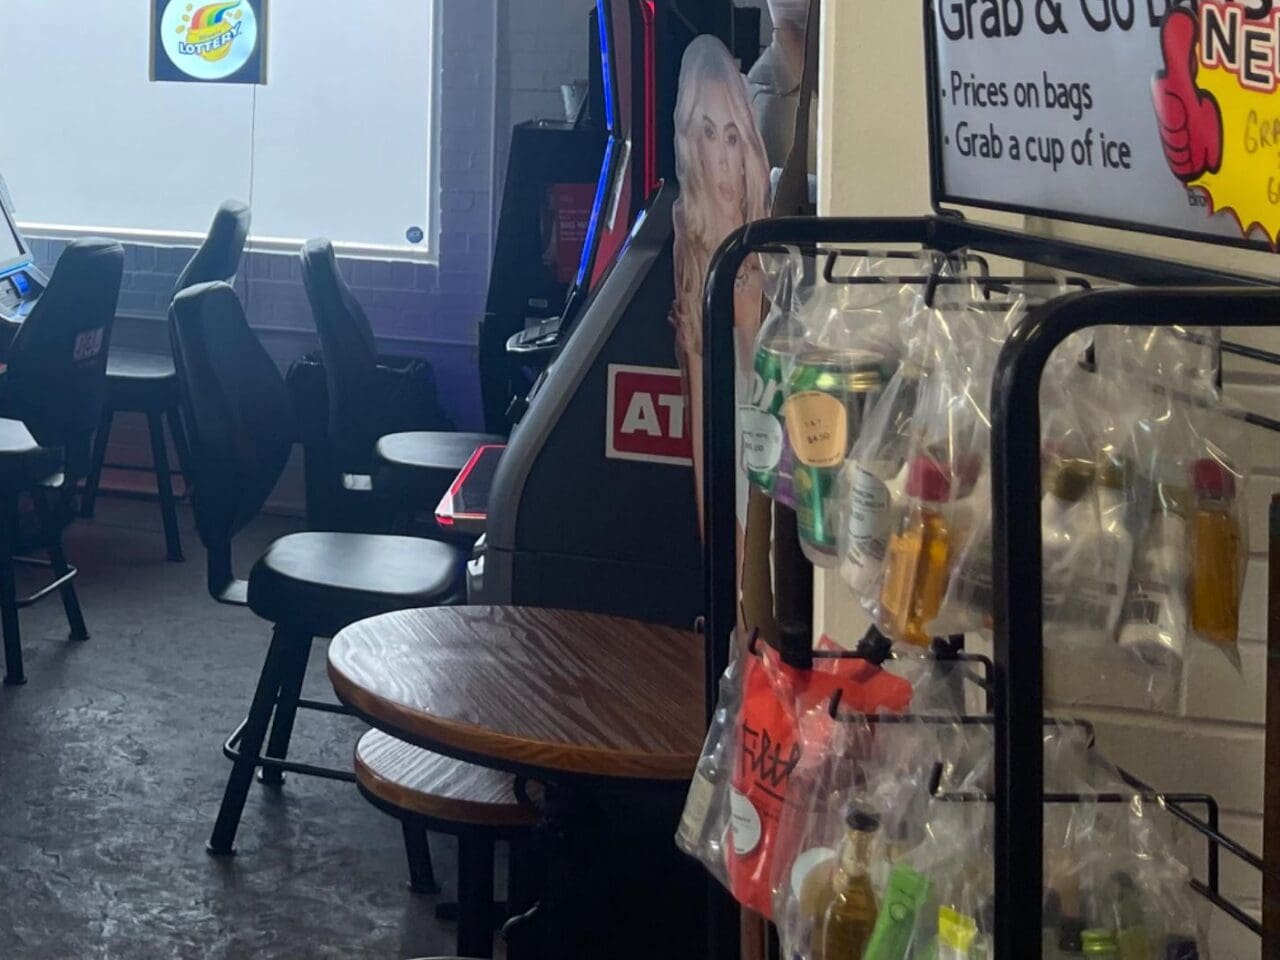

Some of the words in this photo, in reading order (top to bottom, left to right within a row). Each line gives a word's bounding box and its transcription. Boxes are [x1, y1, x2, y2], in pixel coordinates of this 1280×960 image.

[177, 20, 243, 56] LOTTERY
[1204, 4, 1280, 88] NE
[950, 70, 1009, 108] Prices
[1014, 82, 1040, 109] on
[1044, 70, 1094, 122] bags
[955, 120, 1003, 159] Grab
[1009, 135, 1021, 161] a
[1026, 136, 1064, 172] cup
[1071, 127, 1093, 168] of
[1101, 131, 1132, 170] ice
[620, 391, 691, 439] AT
